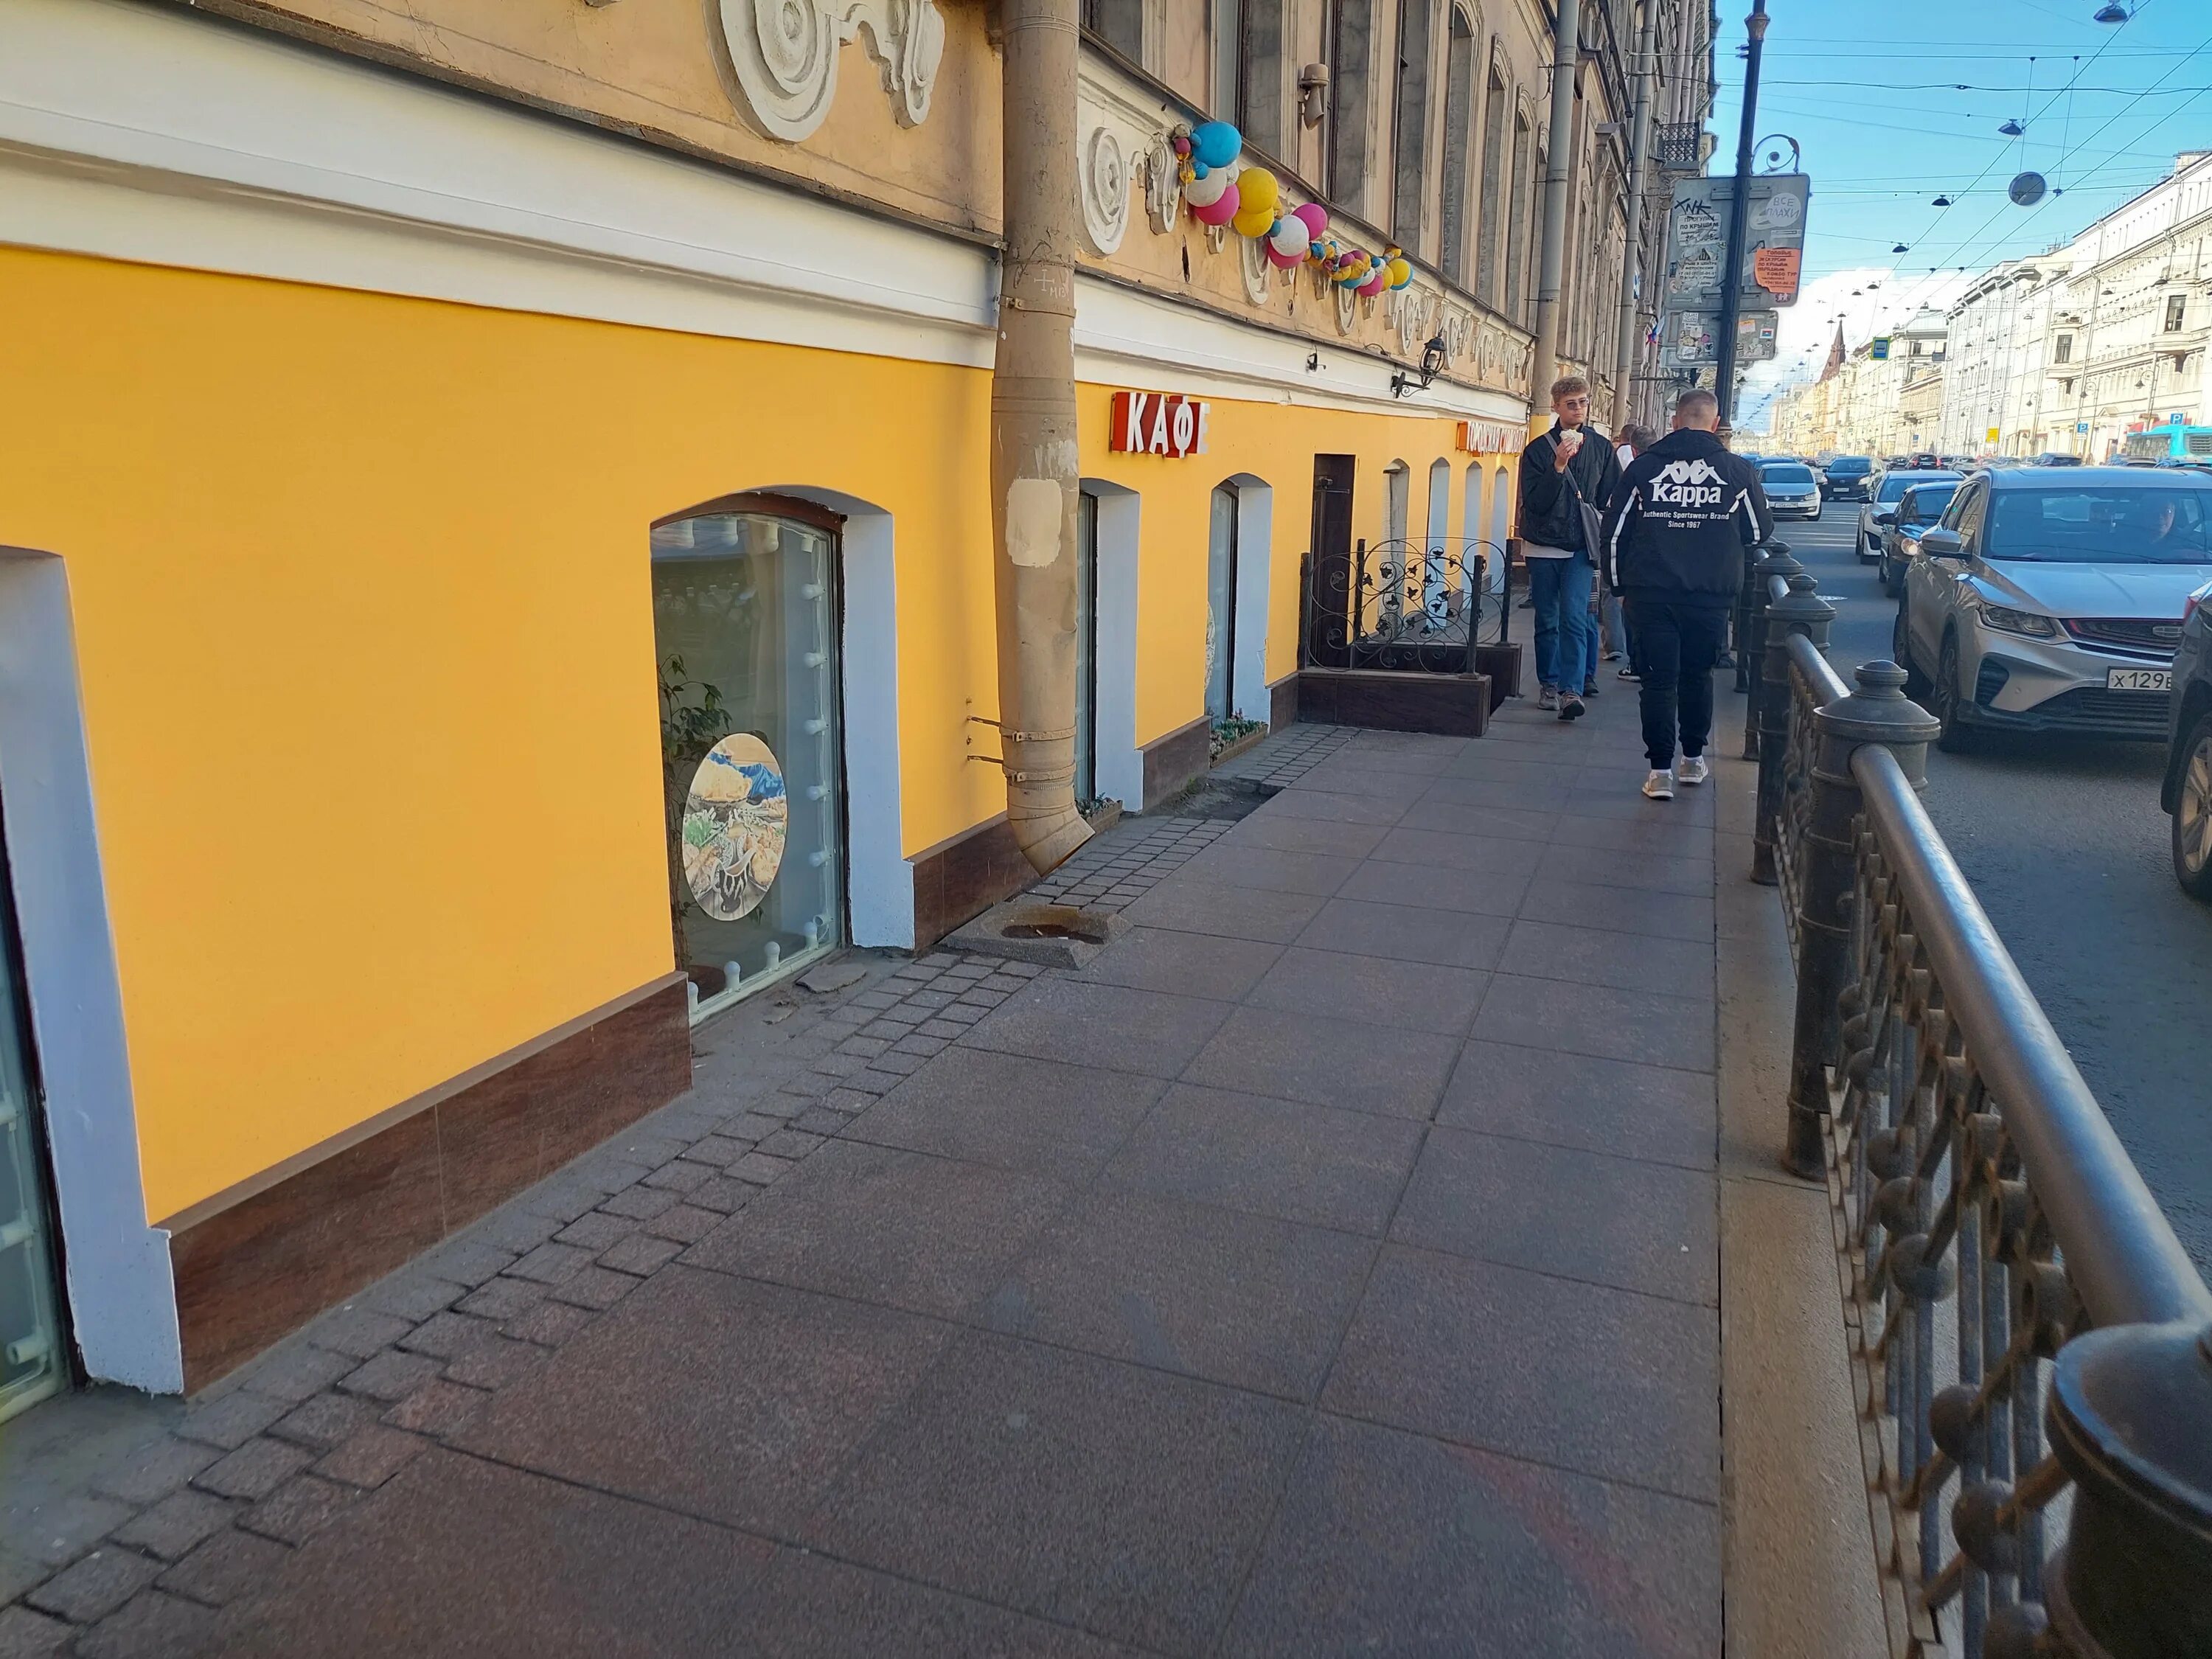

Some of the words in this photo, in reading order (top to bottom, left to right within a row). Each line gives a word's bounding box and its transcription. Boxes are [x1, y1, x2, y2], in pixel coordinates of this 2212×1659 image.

[1773, 197, 1795, 206] ВСЕ
[1127, 392, 1211, 459] КАФЕ
[1651, 483, 1722, 508] Kappa
[1643, 511, 1672, 519] Authentic
[1673, 512, 1708, 521] Sportswear
[1710, 512, 1730, 521] Brand
[1686, 521, 1701, 529] 1967
